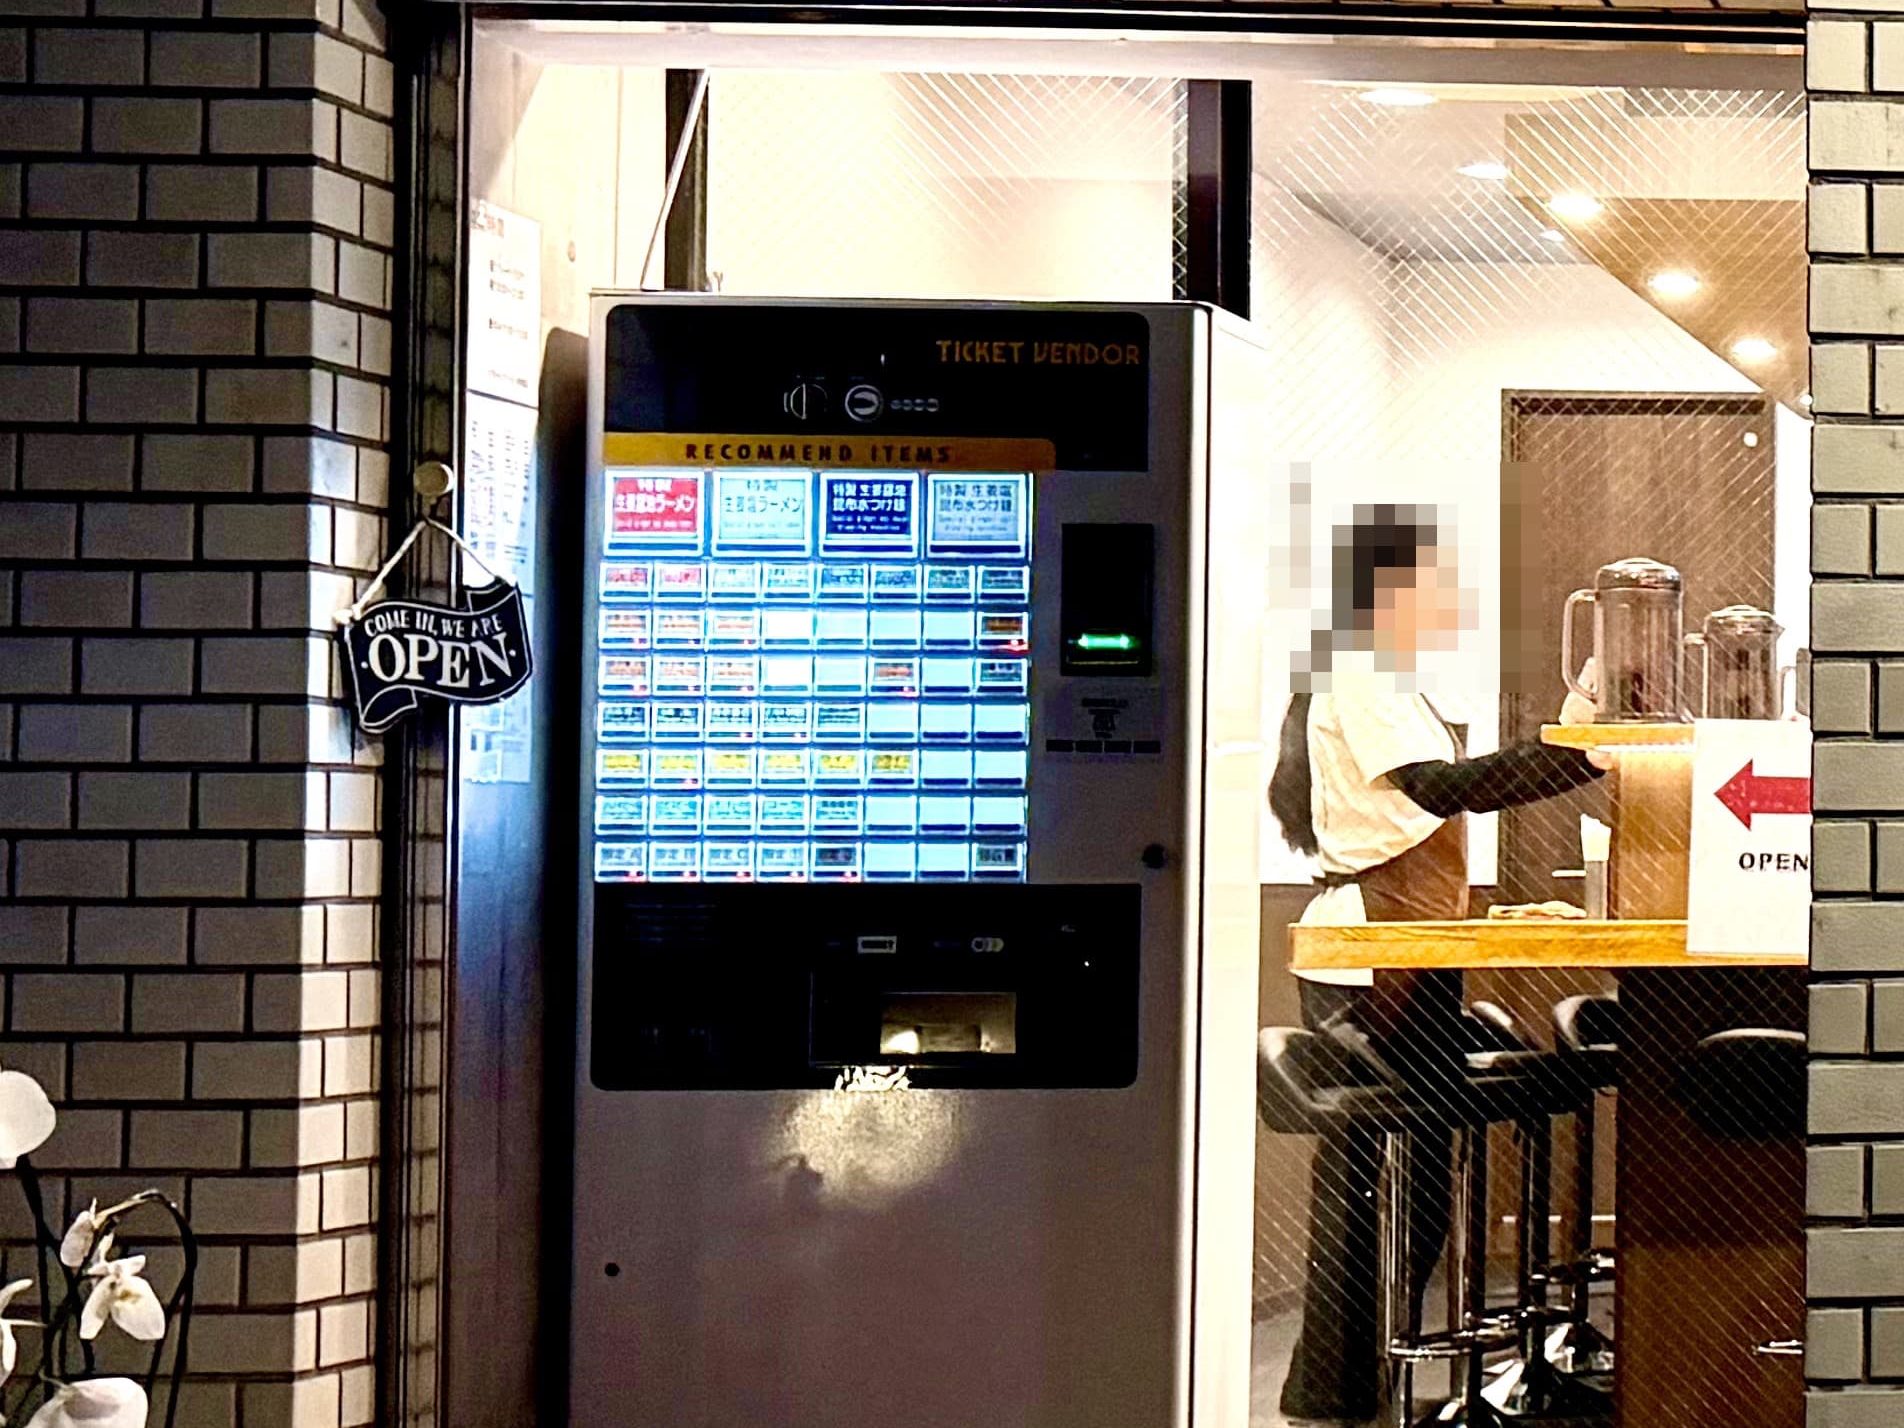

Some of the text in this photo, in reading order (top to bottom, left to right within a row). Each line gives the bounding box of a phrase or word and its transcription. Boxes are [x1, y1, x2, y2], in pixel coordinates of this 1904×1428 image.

[936, 339, 1140, 367] TICKET VENDOR
[684, 443, 953, 463] RECOMMEND ITEMS
[364, 609, 411, 637] COME
[441, 617, 465, 638] WE
[470, 613, 503, 638] ARE
[368, 632, 513, 688] OPEN
[1739, 852, 1809, 871] OPEN
